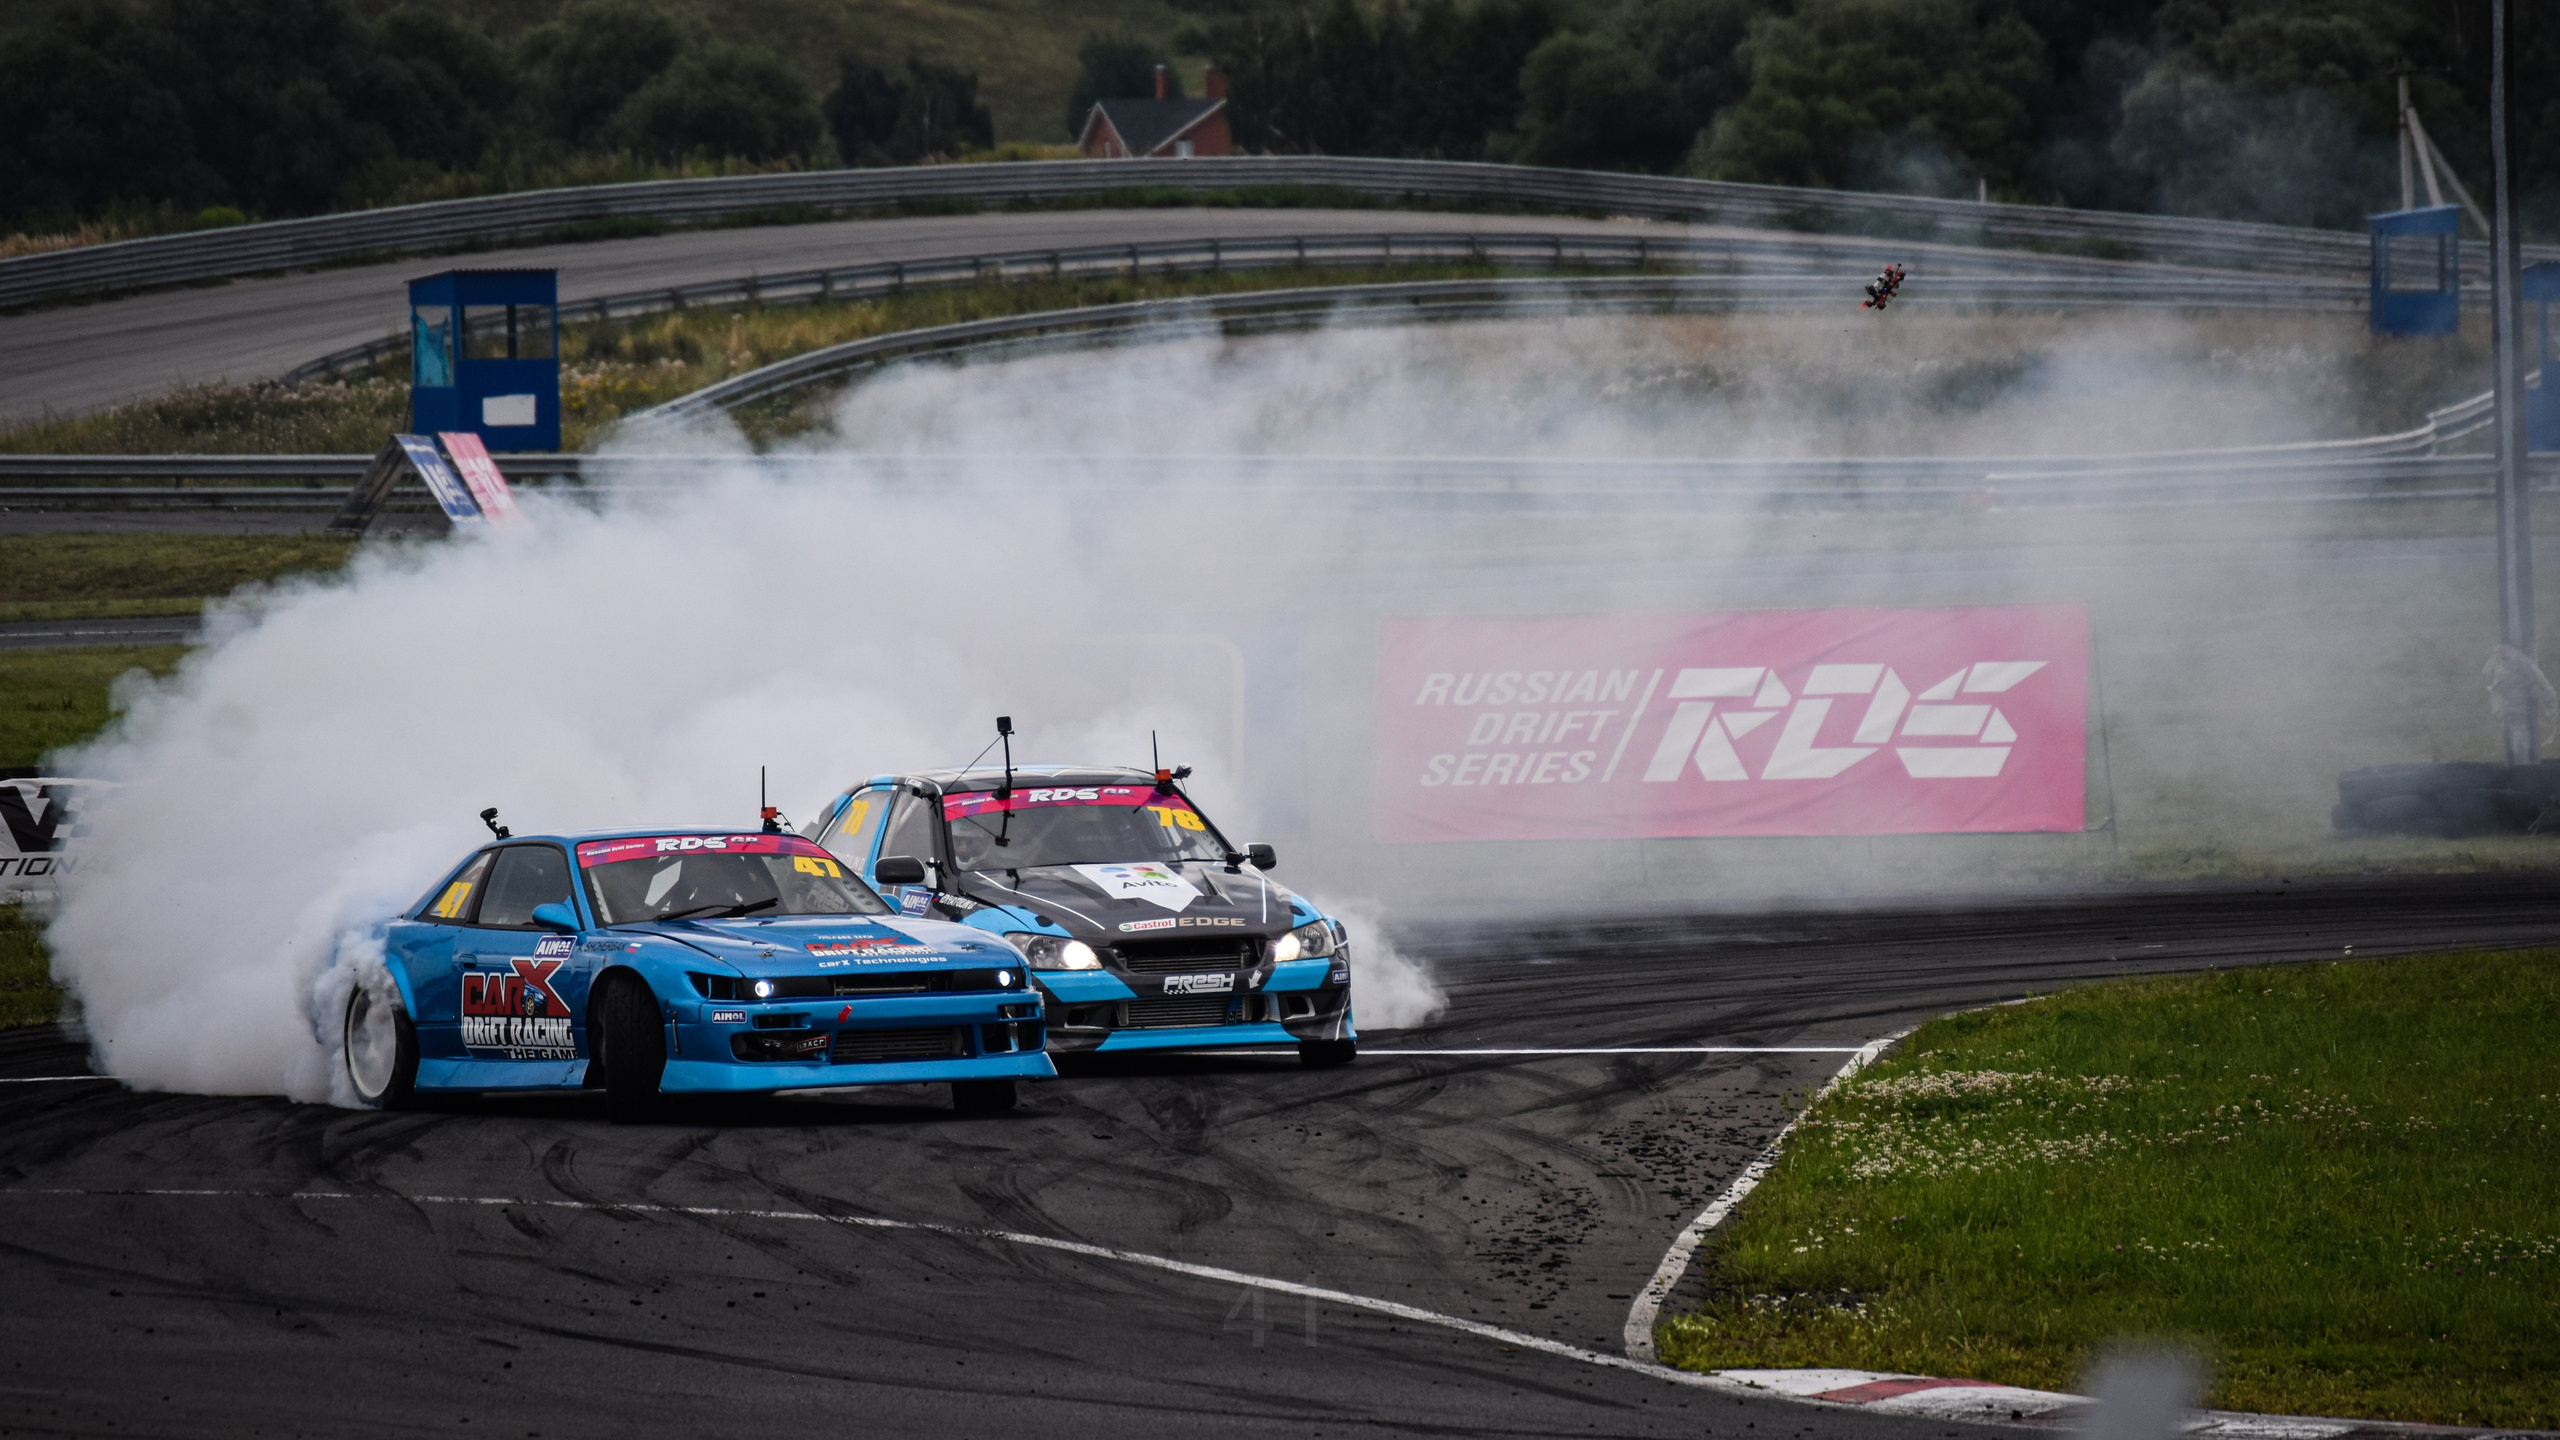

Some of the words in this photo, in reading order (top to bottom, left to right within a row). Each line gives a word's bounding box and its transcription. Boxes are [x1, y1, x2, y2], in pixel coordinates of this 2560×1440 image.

[1416, 669, 1639, 706] RUSSIAN
[1466, 710, 1619, 746] DRIFT
[1642, 660, 2051, 782] RDS
[1419, 750, 1598, 787] SERIES
[1029, 787, 1100, 803] RDS
[840, 799, 870, 836] 78
[1148, 806, 1206, 831] 78
[656, 836, 727, 852] RDS
[793, 855, 842, 878] 47
[1123, 880, 1178, 889] Avito
[437, 881, 473, 918] 47
[1133, 919, 1174, 930] Castrol
[1179, 917, 1246, 927] EDGE
[535, 940, 571, 956] AIMOL
[854, 956, 947, 966] Technologies
[713, 1012, 745, 1022] AIMOL
[510, 1017, 575, 1047] RACING
[504, 1048, 536, 1059] THE
